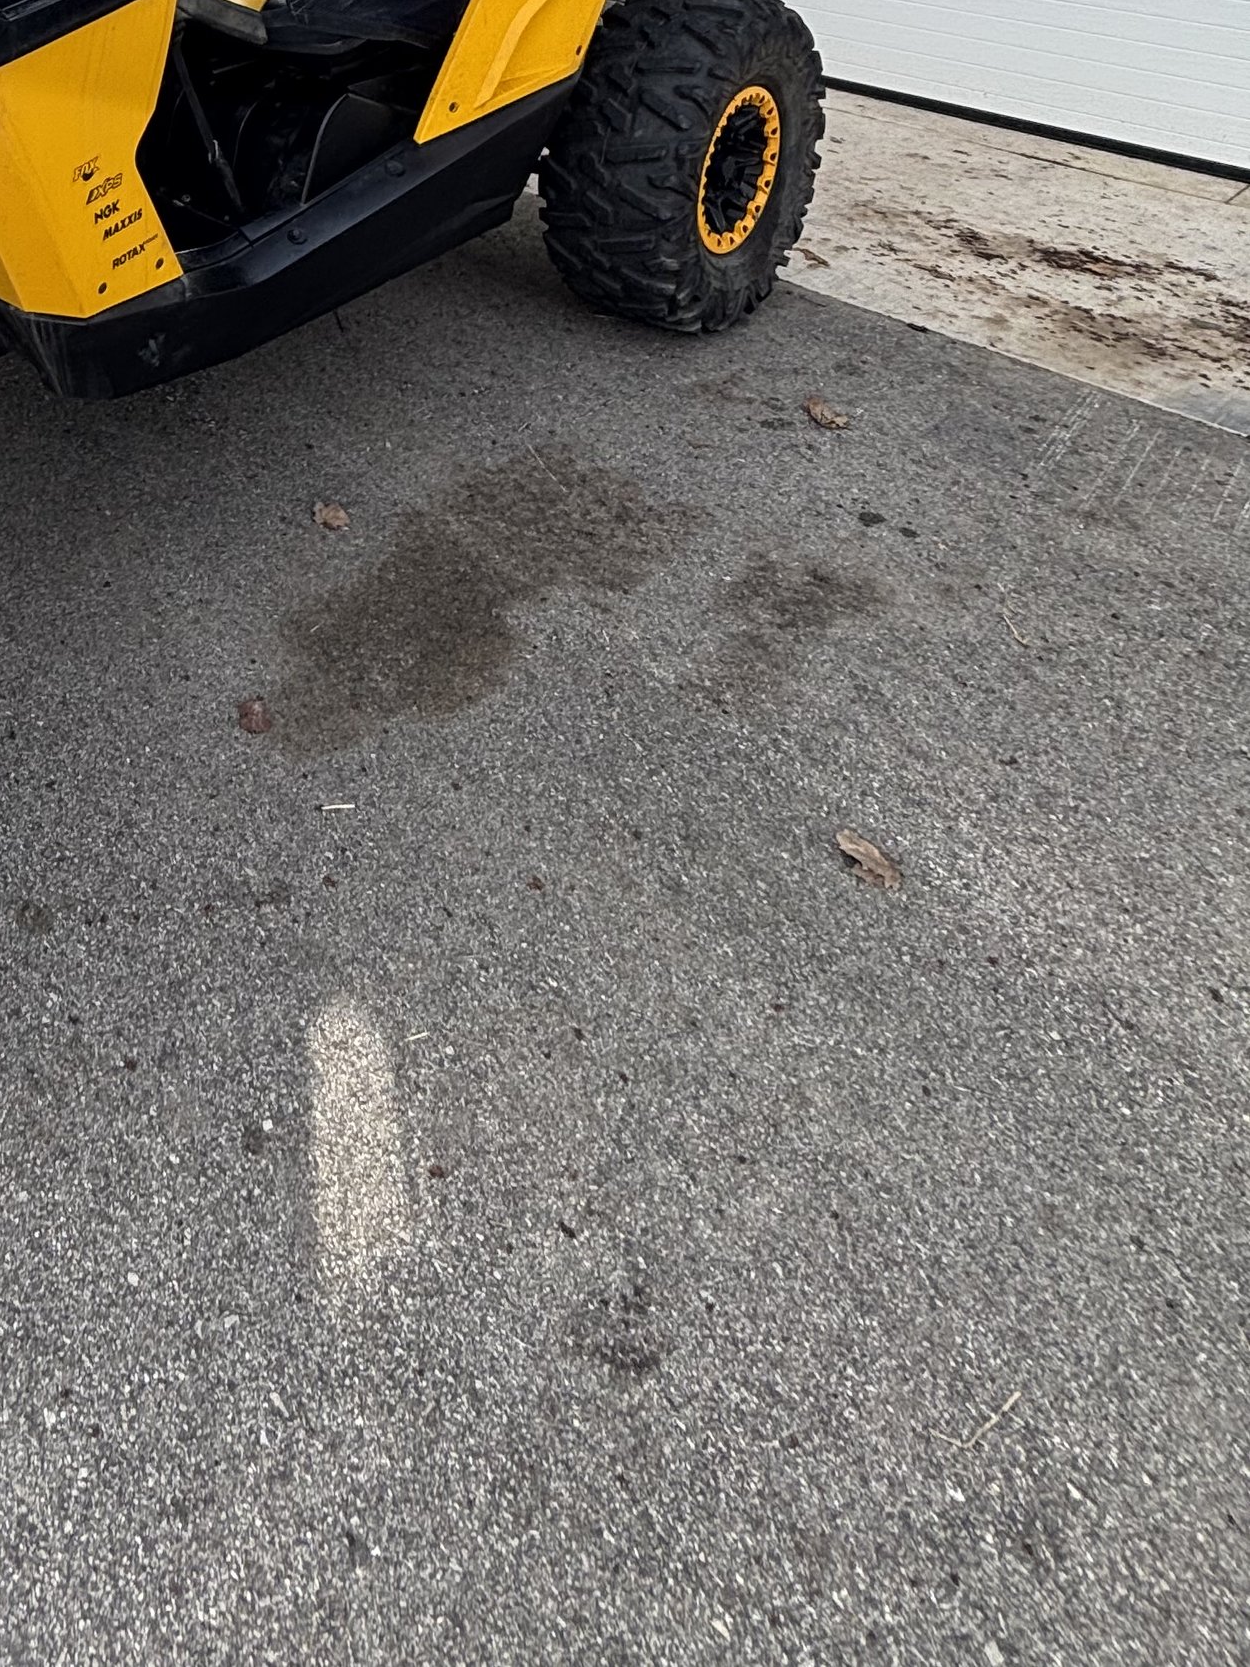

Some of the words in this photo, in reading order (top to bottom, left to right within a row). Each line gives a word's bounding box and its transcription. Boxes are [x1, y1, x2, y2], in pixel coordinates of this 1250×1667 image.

[94, 199, 121, 224] NGK
[102, 207, 143, 241] MAXXIS
[112, 242, 146, 270] ROTAX
